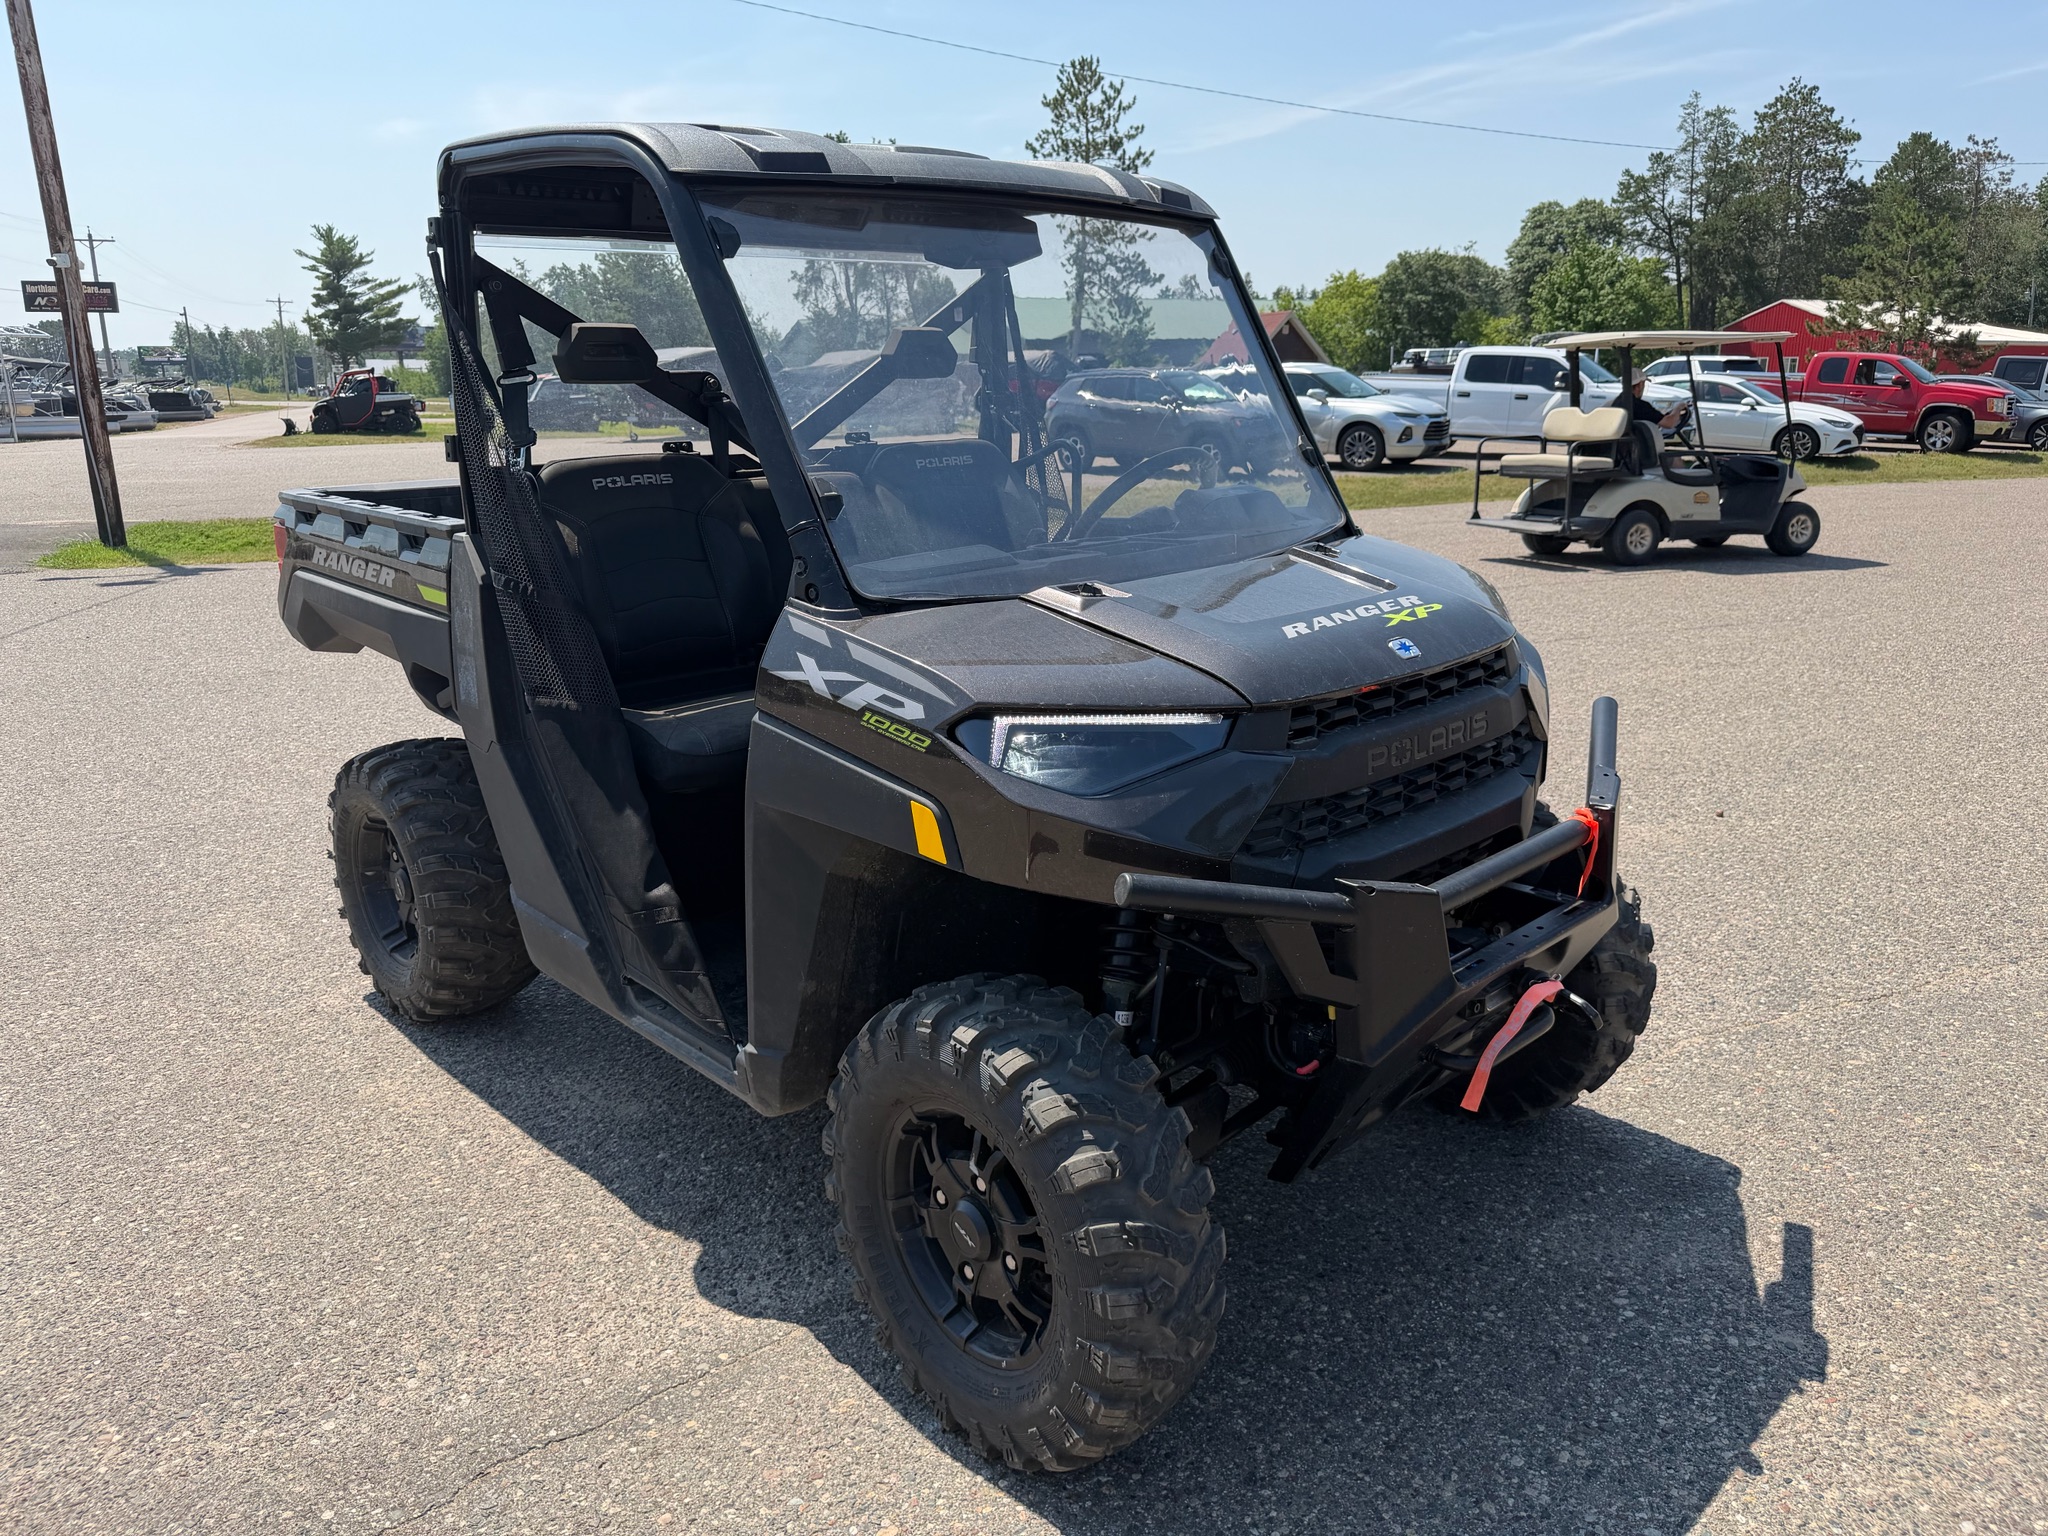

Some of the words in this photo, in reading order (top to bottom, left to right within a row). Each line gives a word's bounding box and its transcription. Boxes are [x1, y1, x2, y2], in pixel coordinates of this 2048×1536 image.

[915, 454, 974, 469] POLARIS
[591, 473, 674, 491] POLARIS
[312, 547, 396, 588] RANGER
[1281, 595, 1425, 639] RANGER
[1381, 603, 1443, 628] XP
[768, 651, 926, 721] XP
[860, 721, 876, 731] DUAL
[877, 728, 911, 746] OVERHEAD
[911, 743, 927, 753] CAM
[861, 710, 933, 748] 1000
[1367, 710, 1488, 776] POLARIS
[854, 1204, 937, 1359] X-TERRAIN
